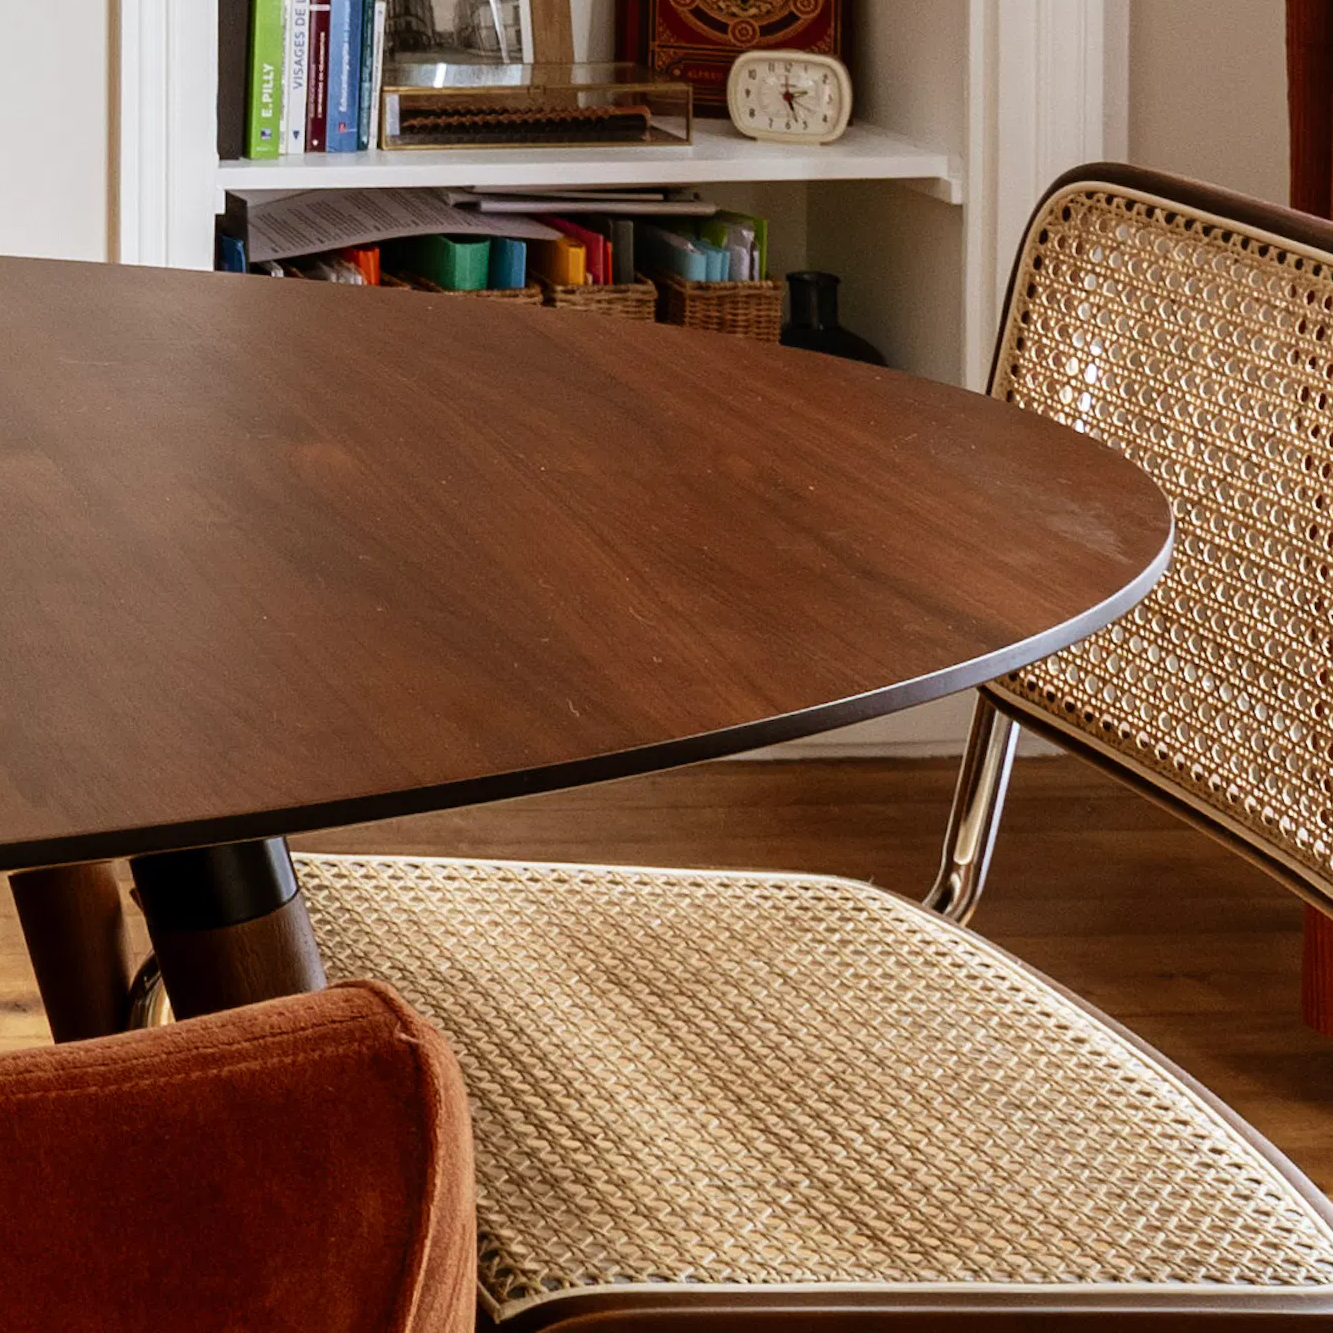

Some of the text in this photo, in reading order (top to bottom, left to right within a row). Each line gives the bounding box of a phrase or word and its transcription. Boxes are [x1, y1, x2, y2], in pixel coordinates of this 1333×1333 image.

[295, 8, 306, 26] DE
[292, 31, 306, 91] VISAGES
[261, 63, 275, 118] E.PILLY
